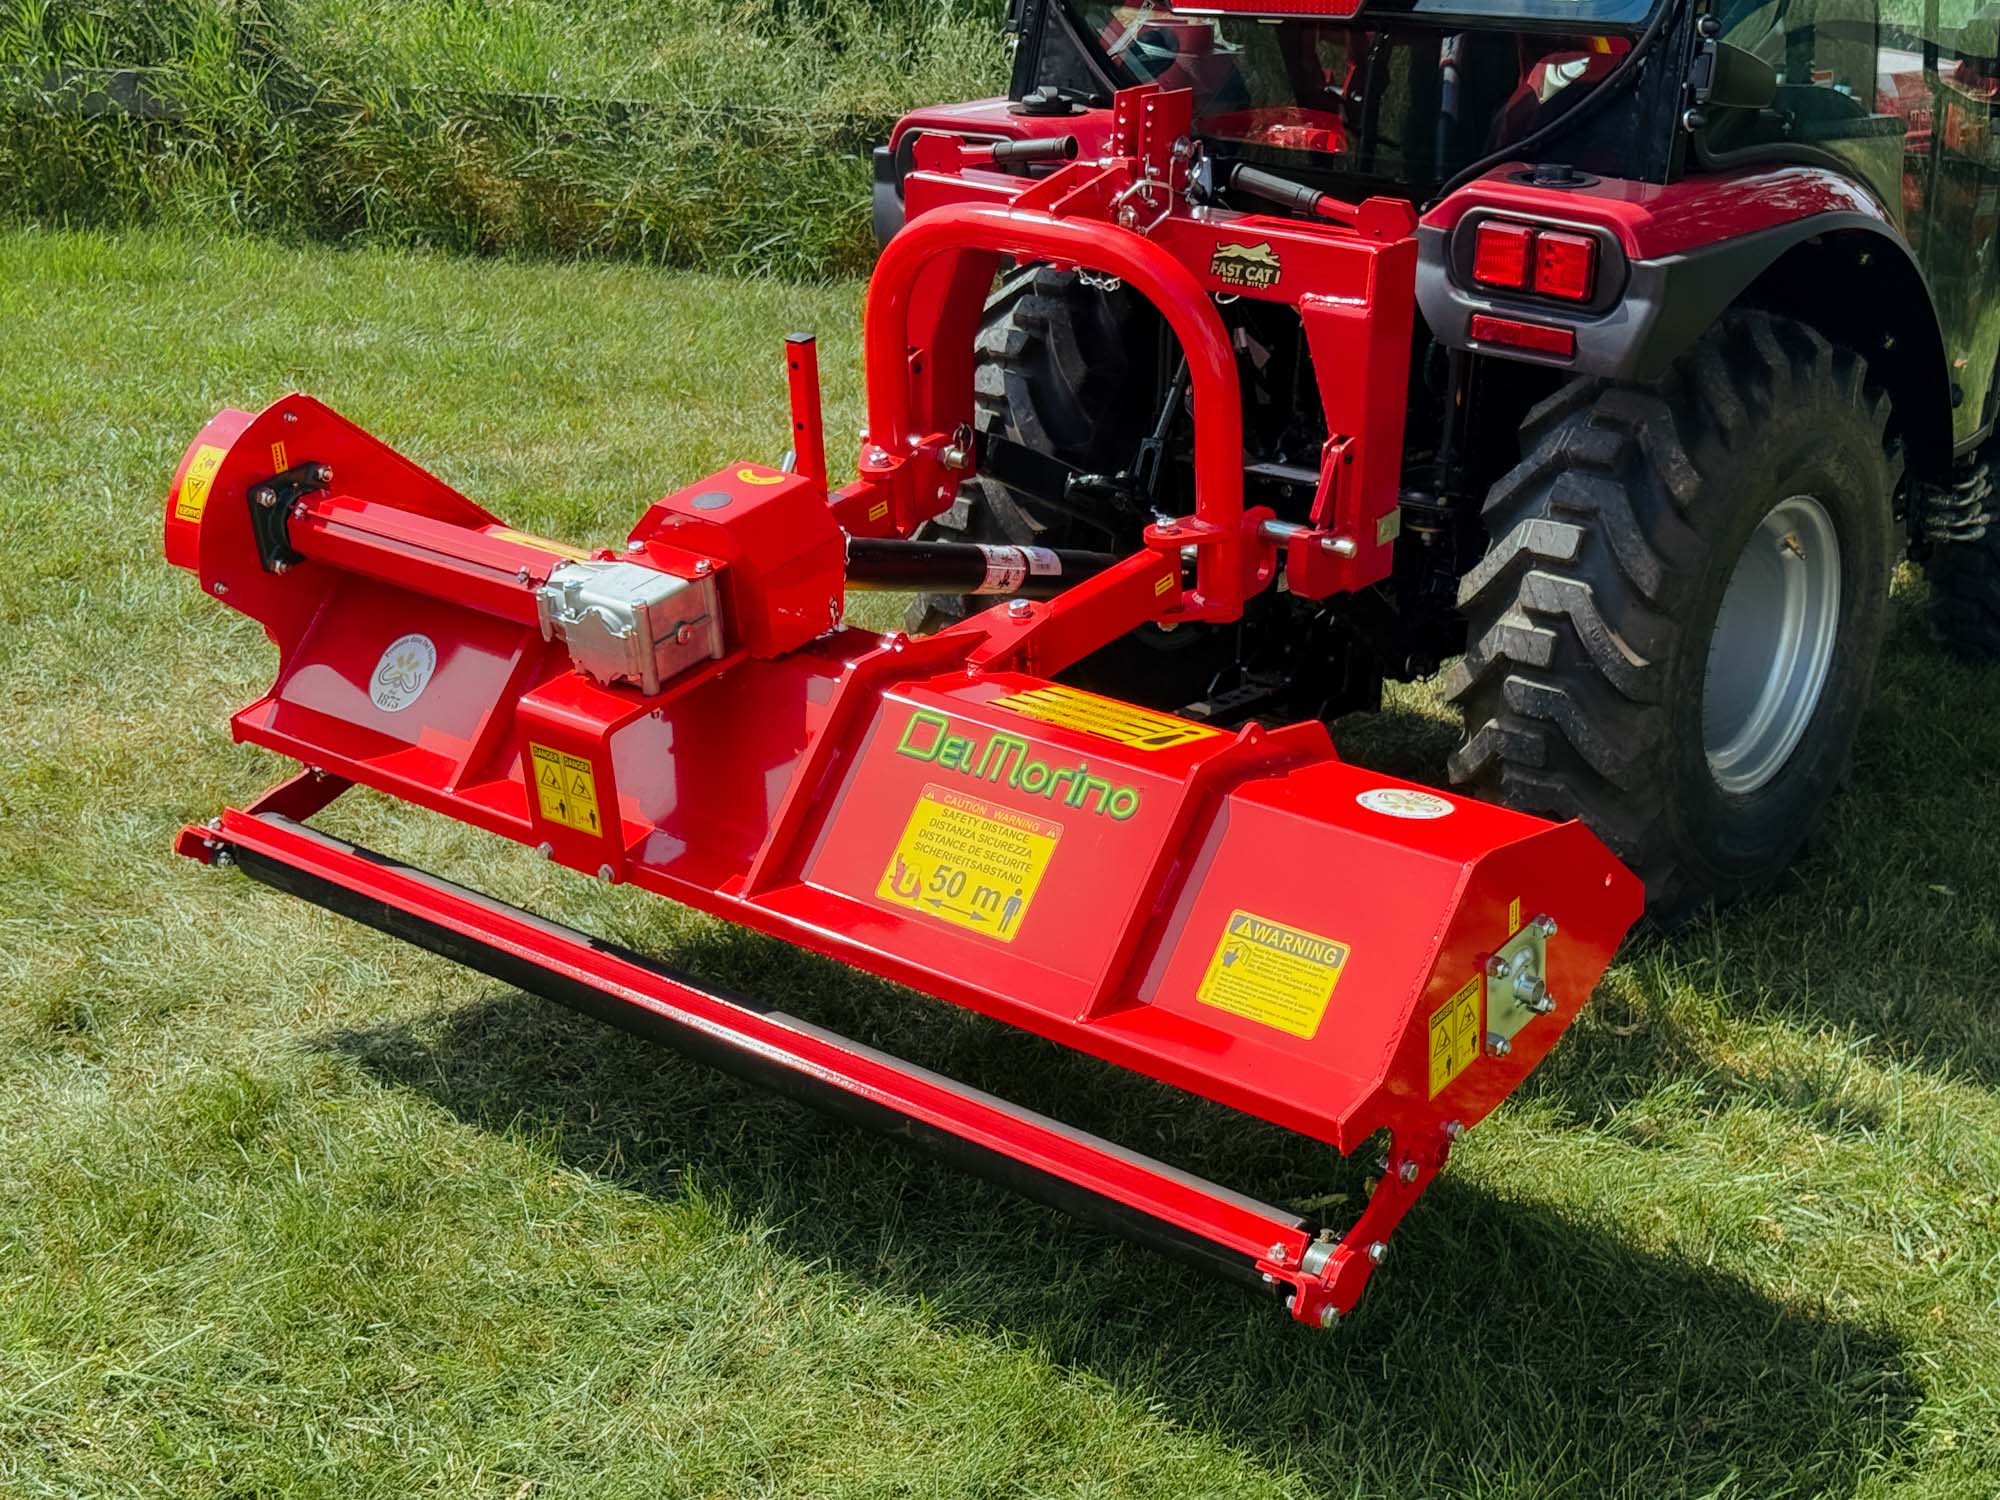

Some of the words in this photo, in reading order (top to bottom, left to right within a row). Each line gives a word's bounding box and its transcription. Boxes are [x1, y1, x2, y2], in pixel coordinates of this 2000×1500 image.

[1211, 259, 1243, 278] FAST
[1245, 266, 1274, 283] CAT
[1274, 270, 1281, 284] I
[1221, 276, 1244, 285] QUICK
[1246, 280, 1269, 290] HITCH
[941, 808, 980, 826] SAFETY
[980, 820, 1031, 845] DISTANCE
[943, 795, 988, 816] CAUTION
[993, 809, 1041, 833] WARNING
[918, 828, 967, 852] DISTANCE
[967, 843, 981, 856] DE
[982, 848, 1033, 873] SECURITE
[929, 817, 977, 841] DISTANZA
[977, 833, 1033, 859] SICUREZZA
[913, 840, 1023, 885] SICHERHEITSABSTAND
[928, 864, 967, 899] 50
[971, 884, 1001, 913] m
[1252, 923, 1338, 965] WARNING
